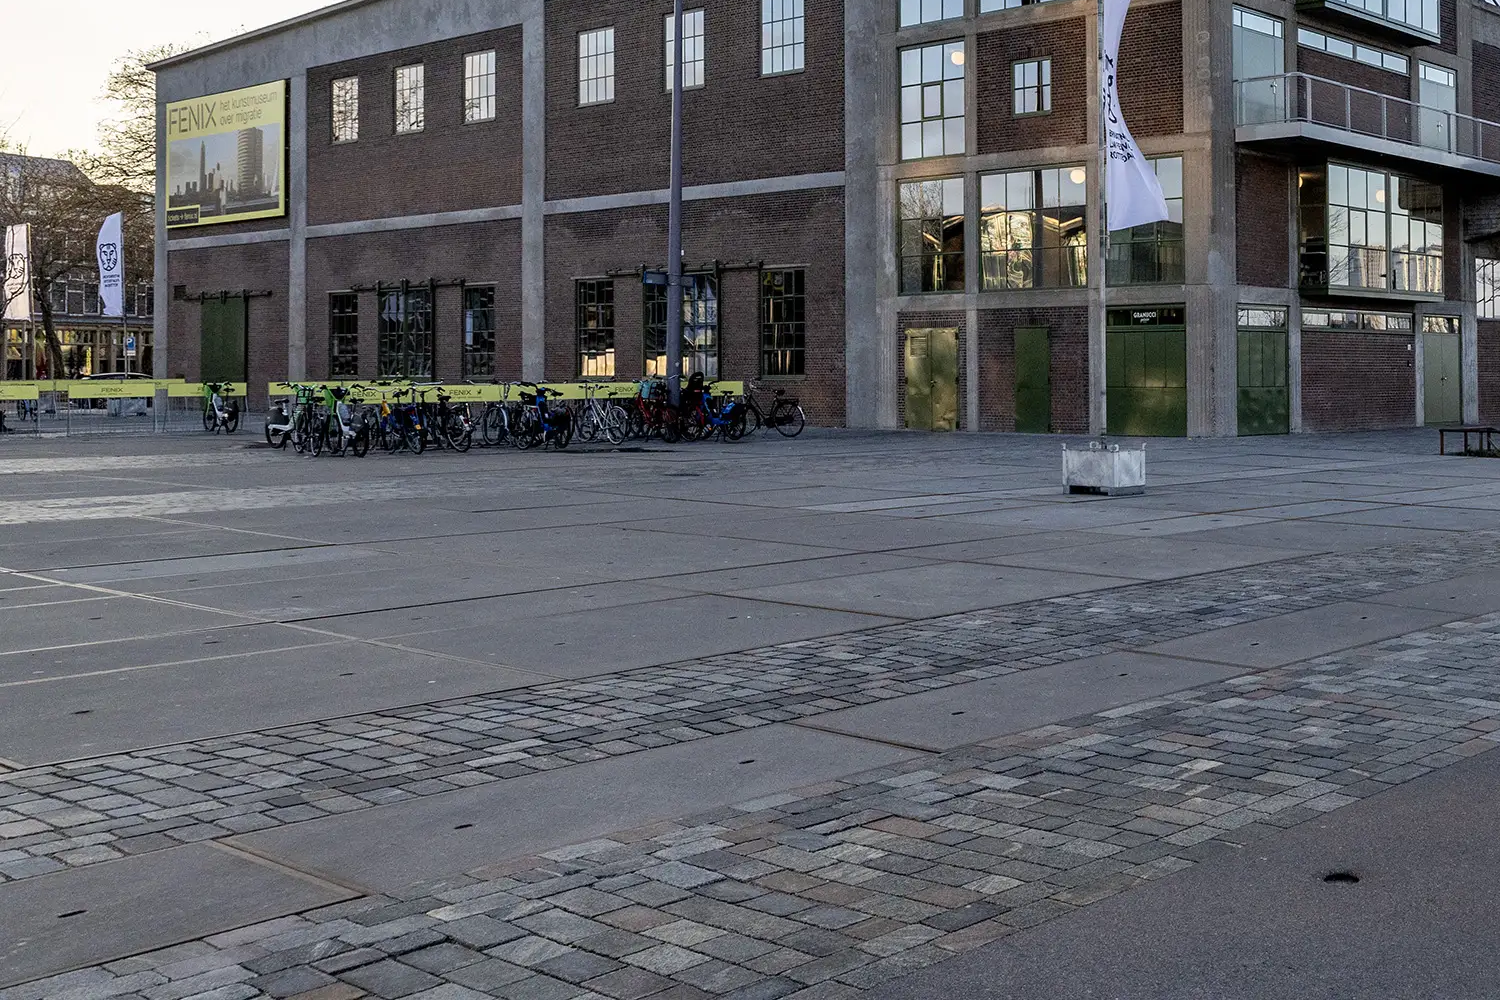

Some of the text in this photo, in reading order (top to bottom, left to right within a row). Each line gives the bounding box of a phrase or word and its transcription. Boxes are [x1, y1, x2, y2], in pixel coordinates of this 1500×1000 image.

[220, 91, 278, 112] het kunstmuseum
[169, 101, 217, 135] FENIX
[220, 108, 263, 126] over migratie
